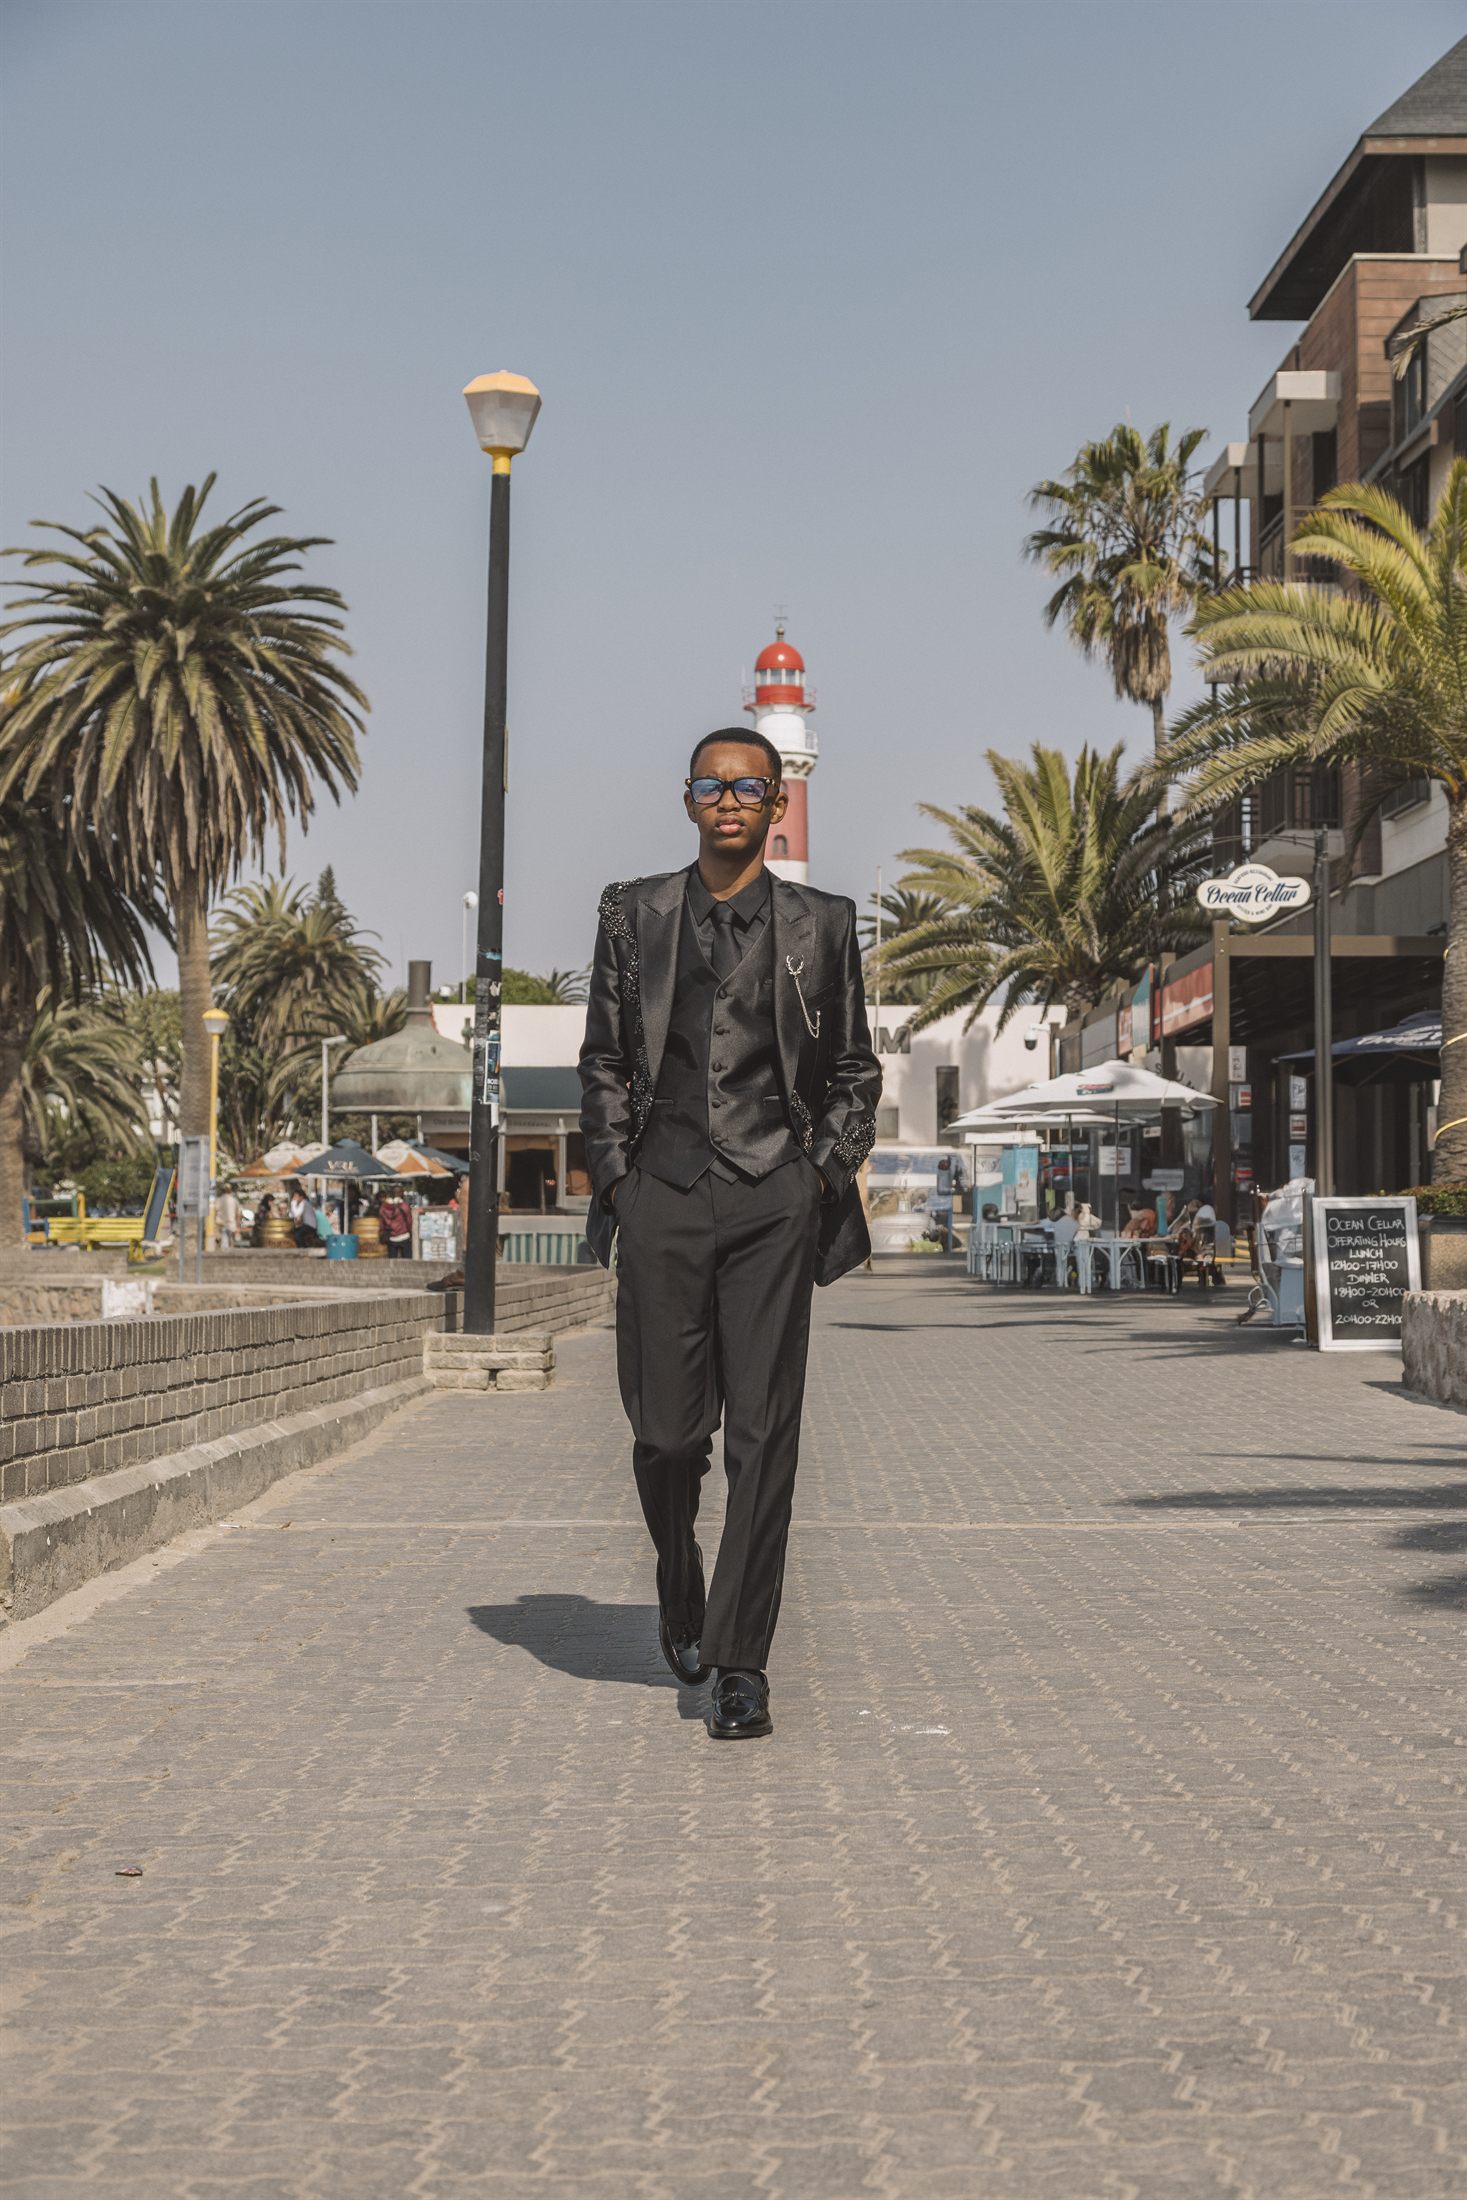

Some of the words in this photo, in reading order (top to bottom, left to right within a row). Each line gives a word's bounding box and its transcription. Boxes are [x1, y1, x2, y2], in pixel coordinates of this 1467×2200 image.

[1207, 884, 1253, 904] Ocean
[1254, 882, 1301, 903] Cellar
[873, 1026, 912, 1054] M
[1328, 1217, 1364, 1231] OCEAN
[1368, 1215, 1405, 1230] CELLAR
[1327, 1235, 1378, 1248] OPERATING
[1379, 1233, 1407, 1248] HOURS
[1349, 1248, 1384, 1259] LUNCH
[1346, 1272, 1390, 1285] DINNER
[1362, 1299, 1379, 1309] OR
